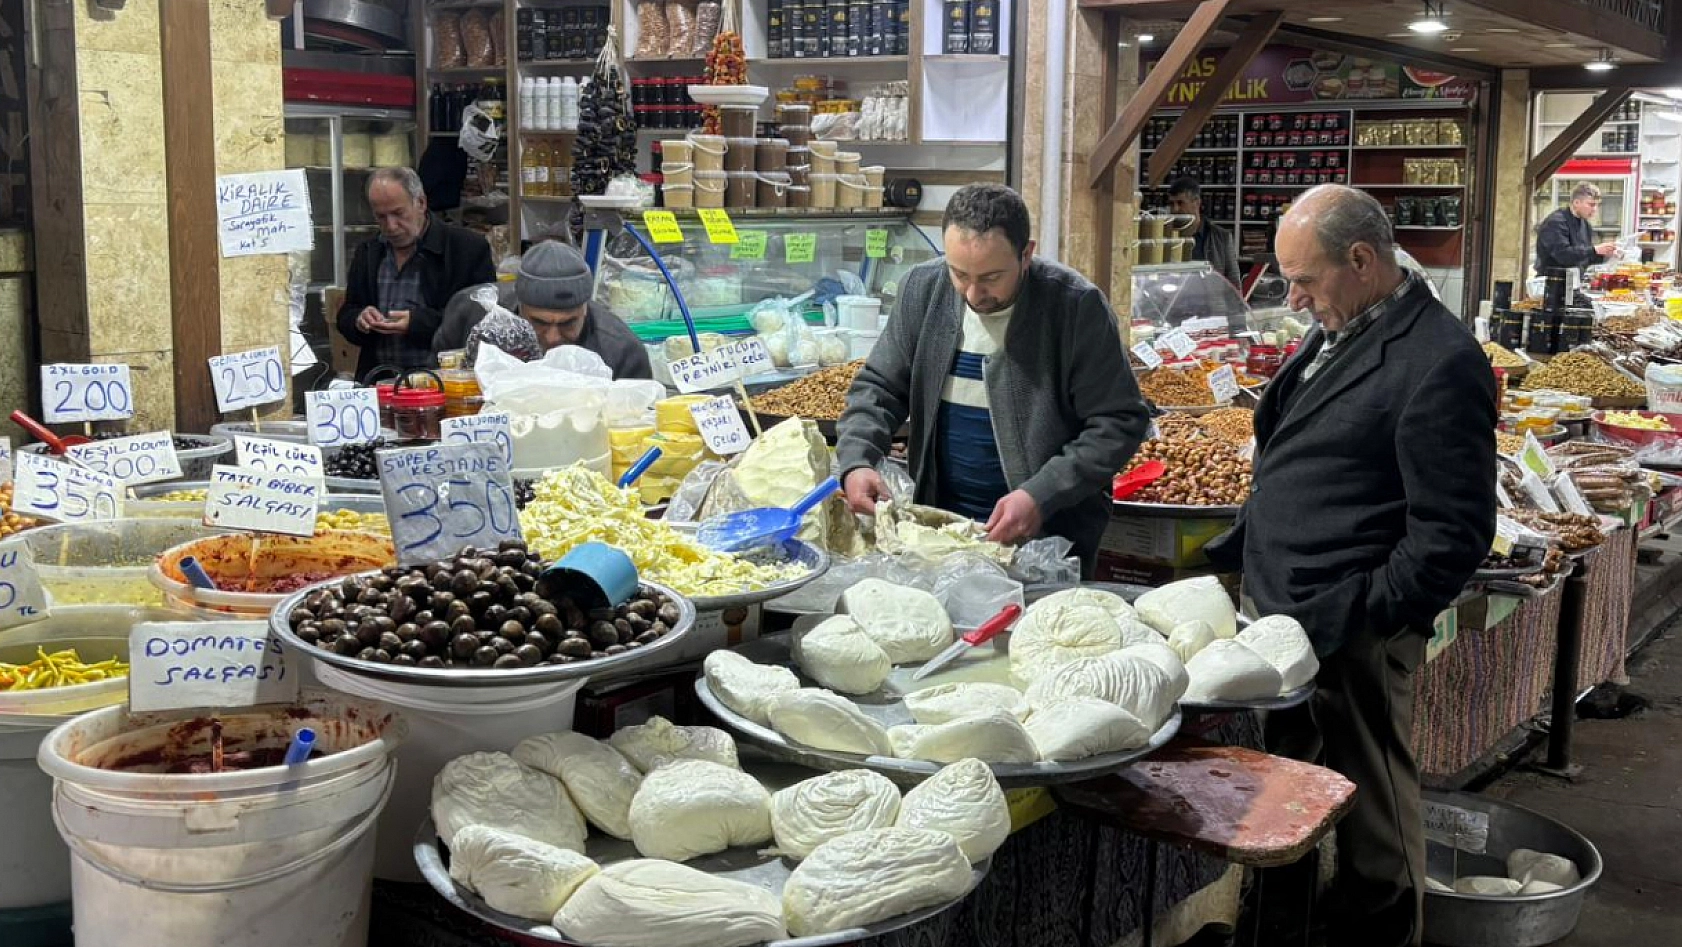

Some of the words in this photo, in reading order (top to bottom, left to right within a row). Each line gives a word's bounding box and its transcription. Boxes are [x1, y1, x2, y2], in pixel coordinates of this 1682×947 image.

[49, 366, 77, 376] 2XL
[81, 366, 119, 375] GOLD
[222, 359, 283, 403] 250
[55, 380, 128, 413] 200
[317, 403, 378, 443] 300
[412, 457, 502, 476] KESTANE
[396, 479, 512, 551] 350
[16, 605, 39, 616] TL
[146, 635, 284, 657] DOMATES
